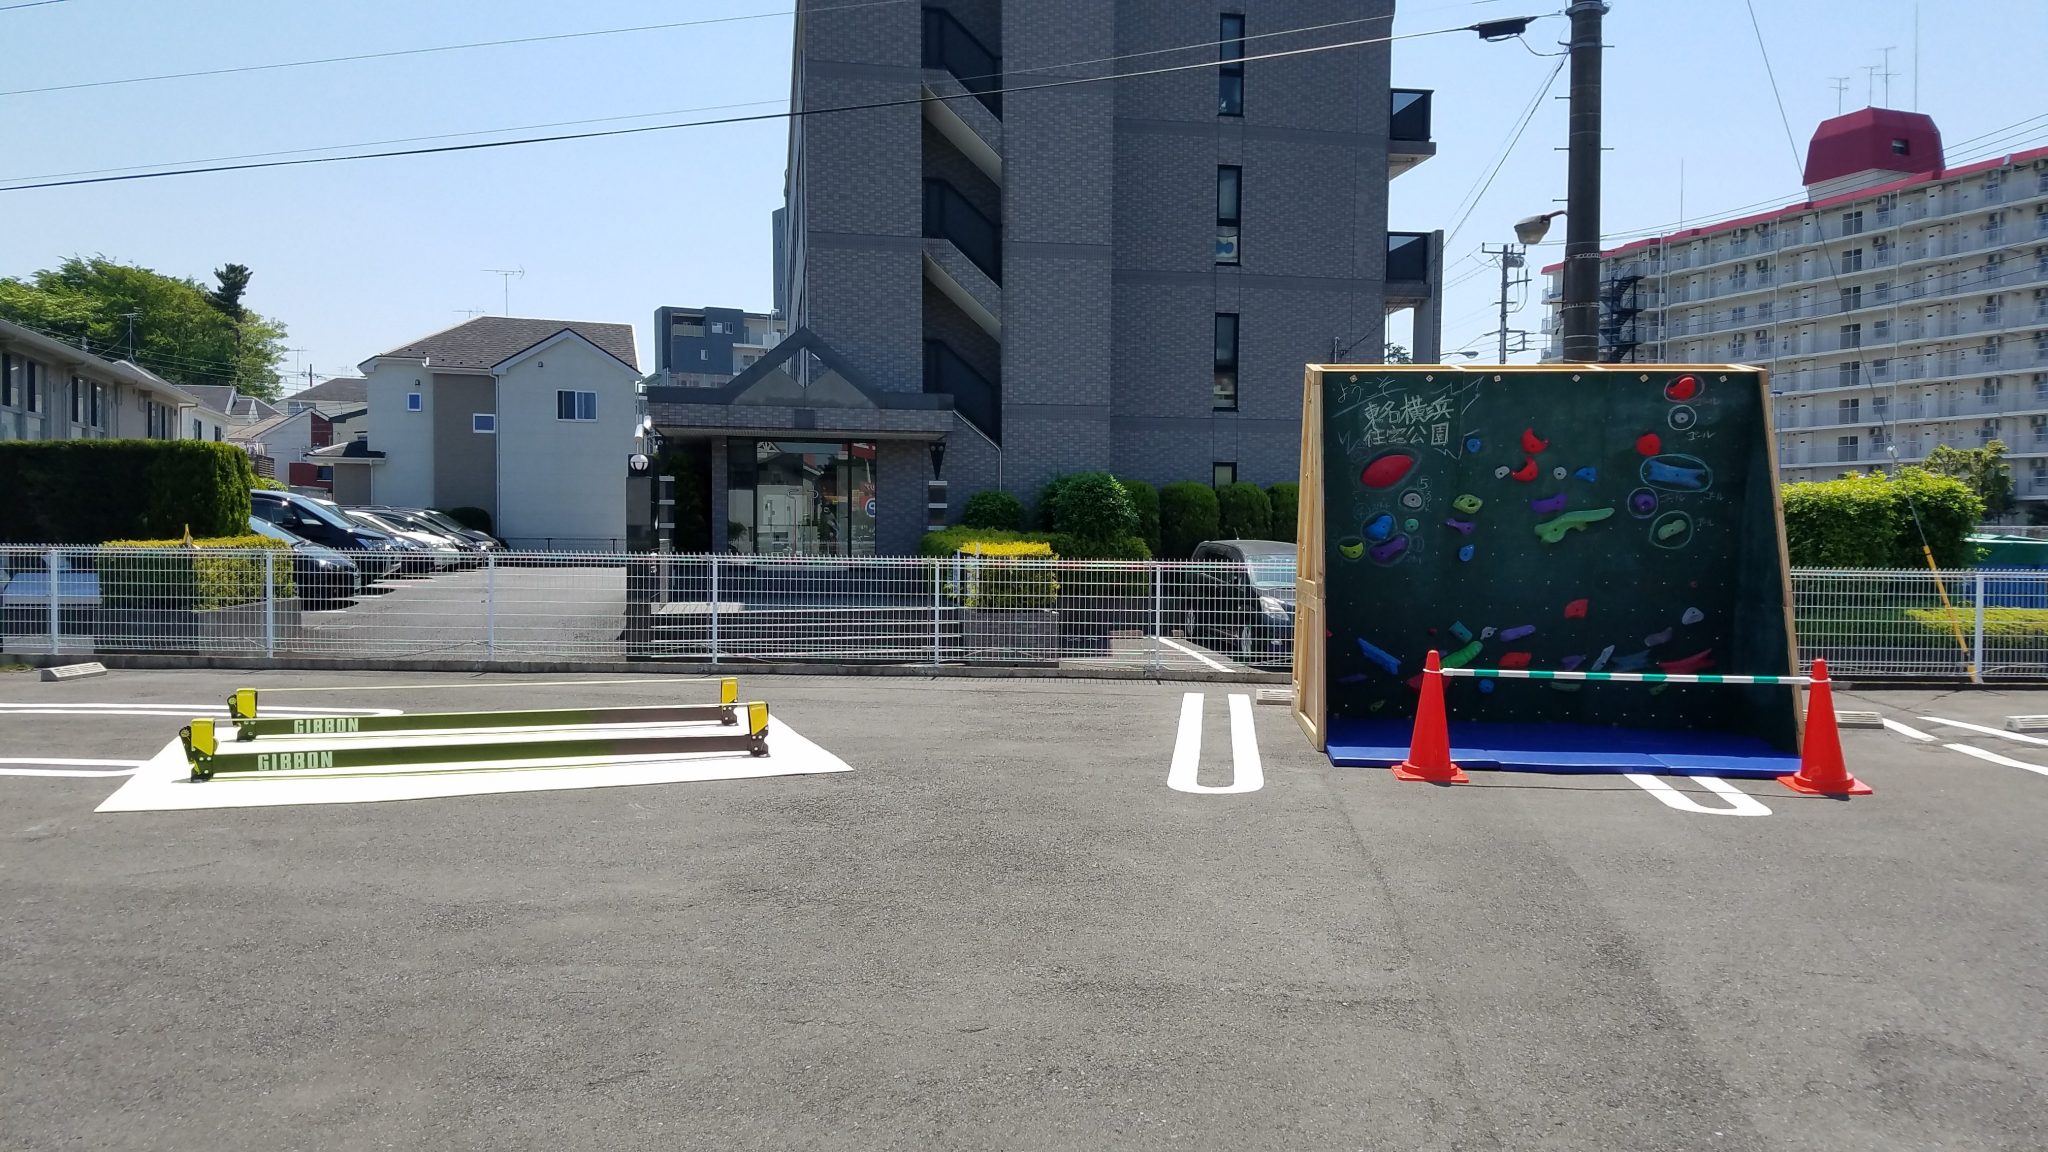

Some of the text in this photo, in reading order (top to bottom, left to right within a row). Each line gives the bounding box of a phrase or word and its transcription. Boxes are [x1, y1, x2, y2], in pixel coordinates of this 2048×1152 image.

[1362, 422, 1450, 447] 住宅公園
[294, 718, 359, 734] GIBBON
[257, 751, 333, 771] GIBBON
